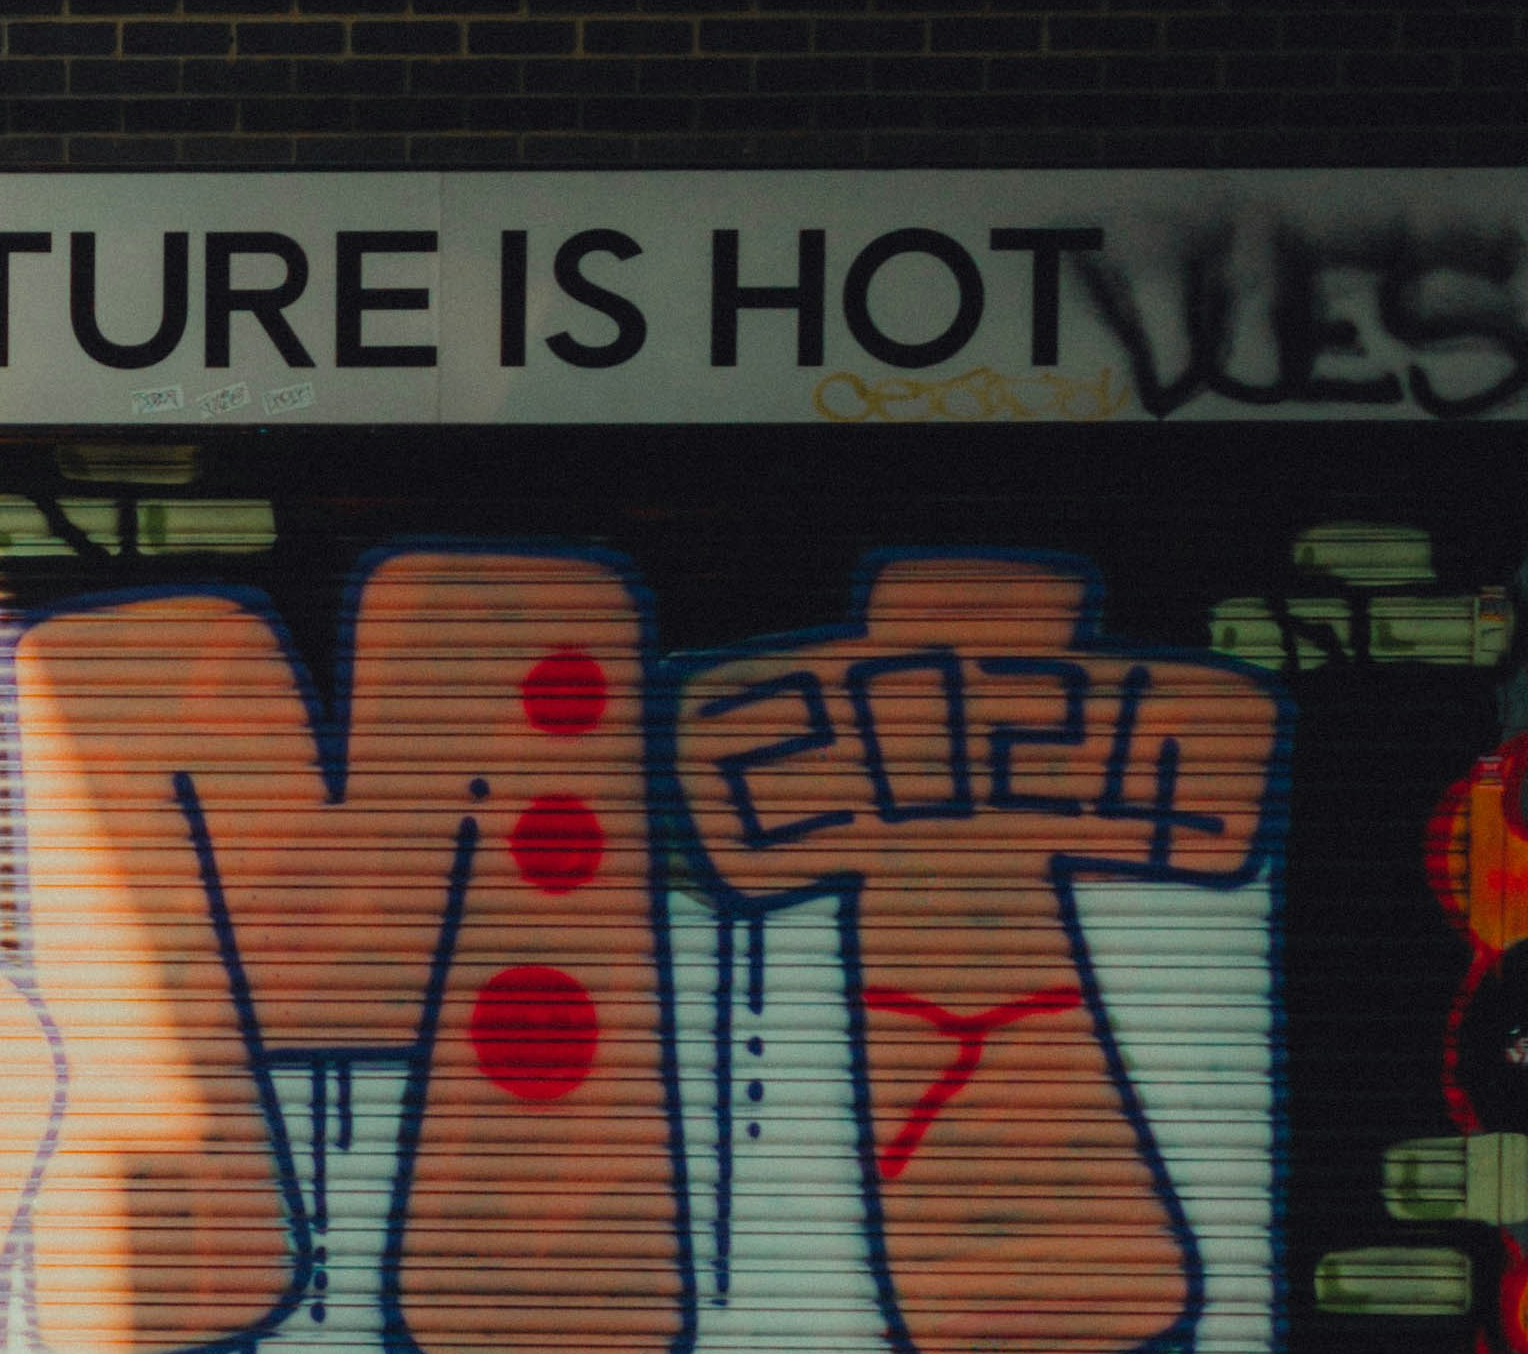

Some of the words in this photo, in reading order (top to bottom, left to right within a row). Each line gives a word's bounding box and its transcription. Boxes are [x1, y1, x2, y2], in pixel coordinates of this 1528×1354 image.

[500, 228, 647, 368] IS
[710, 227, 1104, 368] HOT
[696, 646, 1226, 867] 2024
